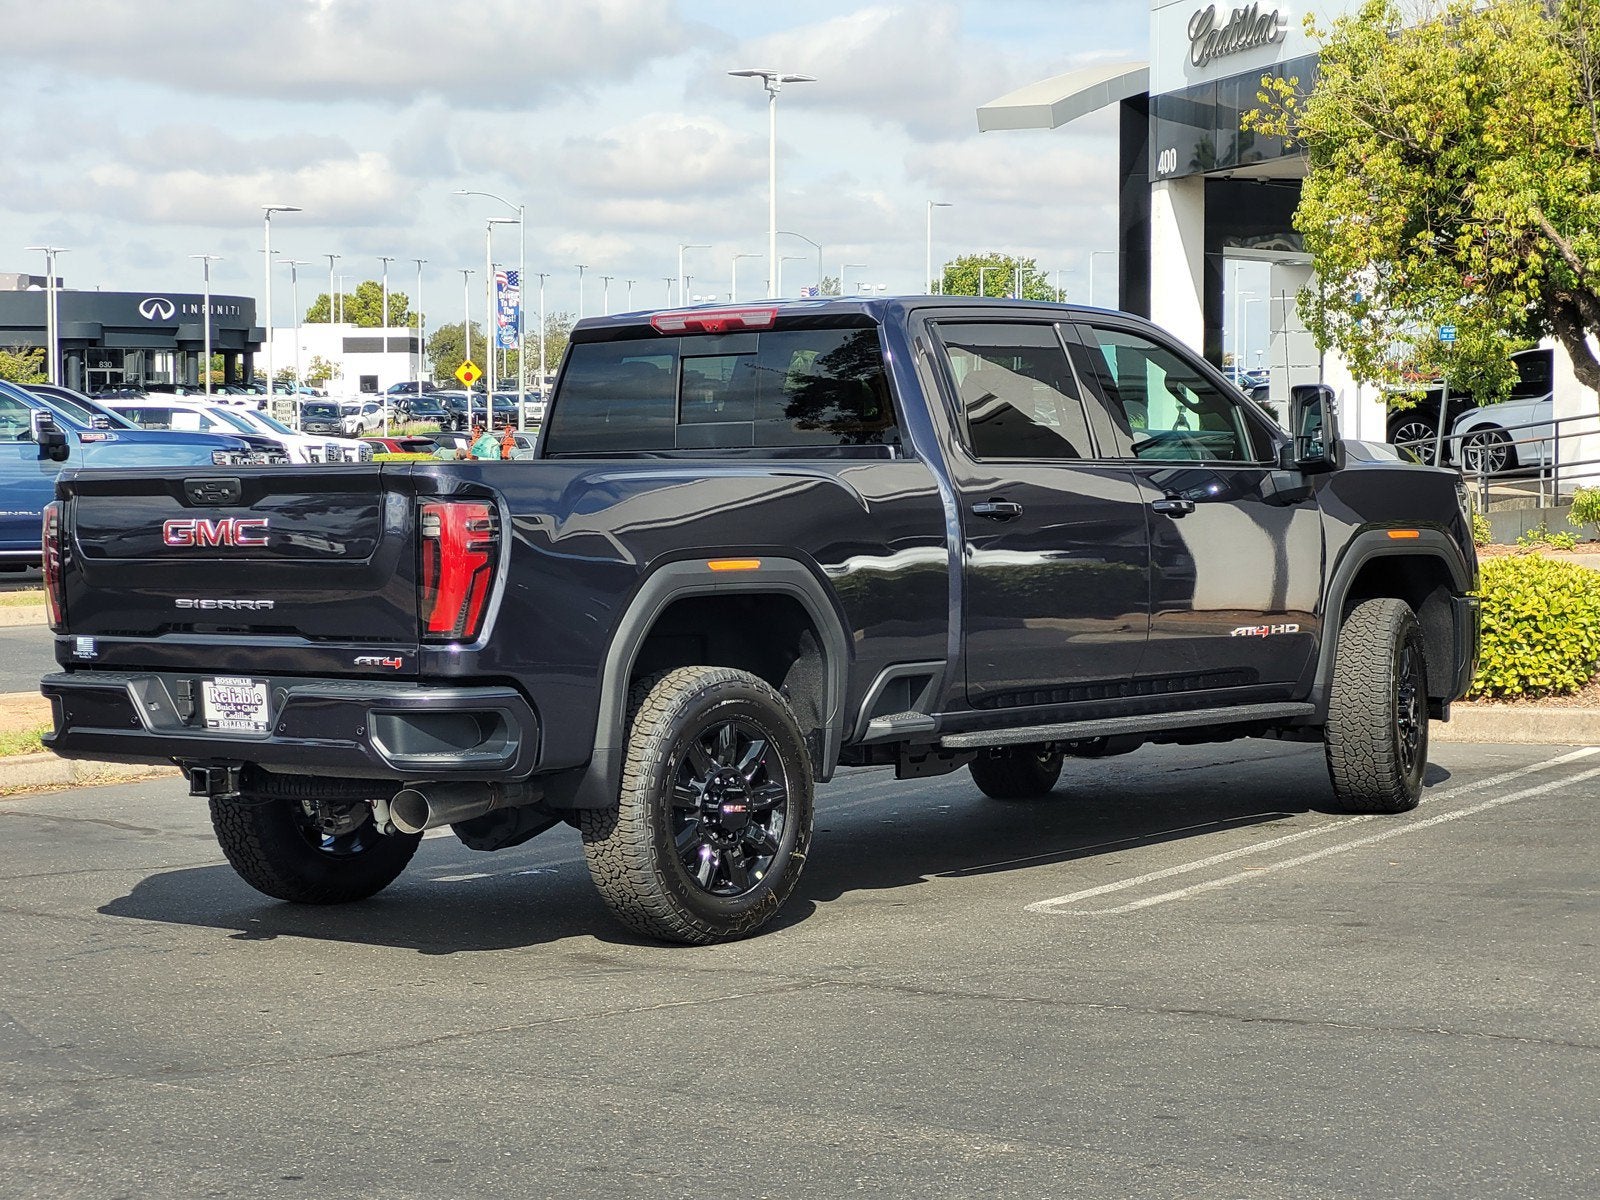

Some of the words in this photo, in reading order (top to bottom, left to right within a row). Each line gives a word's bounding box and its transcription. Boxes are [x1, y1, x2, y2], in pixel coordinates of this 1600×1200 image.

[1188, 1, 1280, 67] Cadillac
[1157, 147, 1177, 175] 400
[182, 303, 240, 316] INFINITI
[503, 307, 514, 315] The
[162, 517, 270, 547] GMC
[174, 598, 275, 610] SIERRA
[1230, 625, 1269, 639] AT4
[1271, 623, 1300, 634] HD
[353, 656, 403, 670] AT4
[208, 687, 263, 705] Reliable
[215, 703, 236, 712] Buick
[242, 705, 259, 714] GMC
